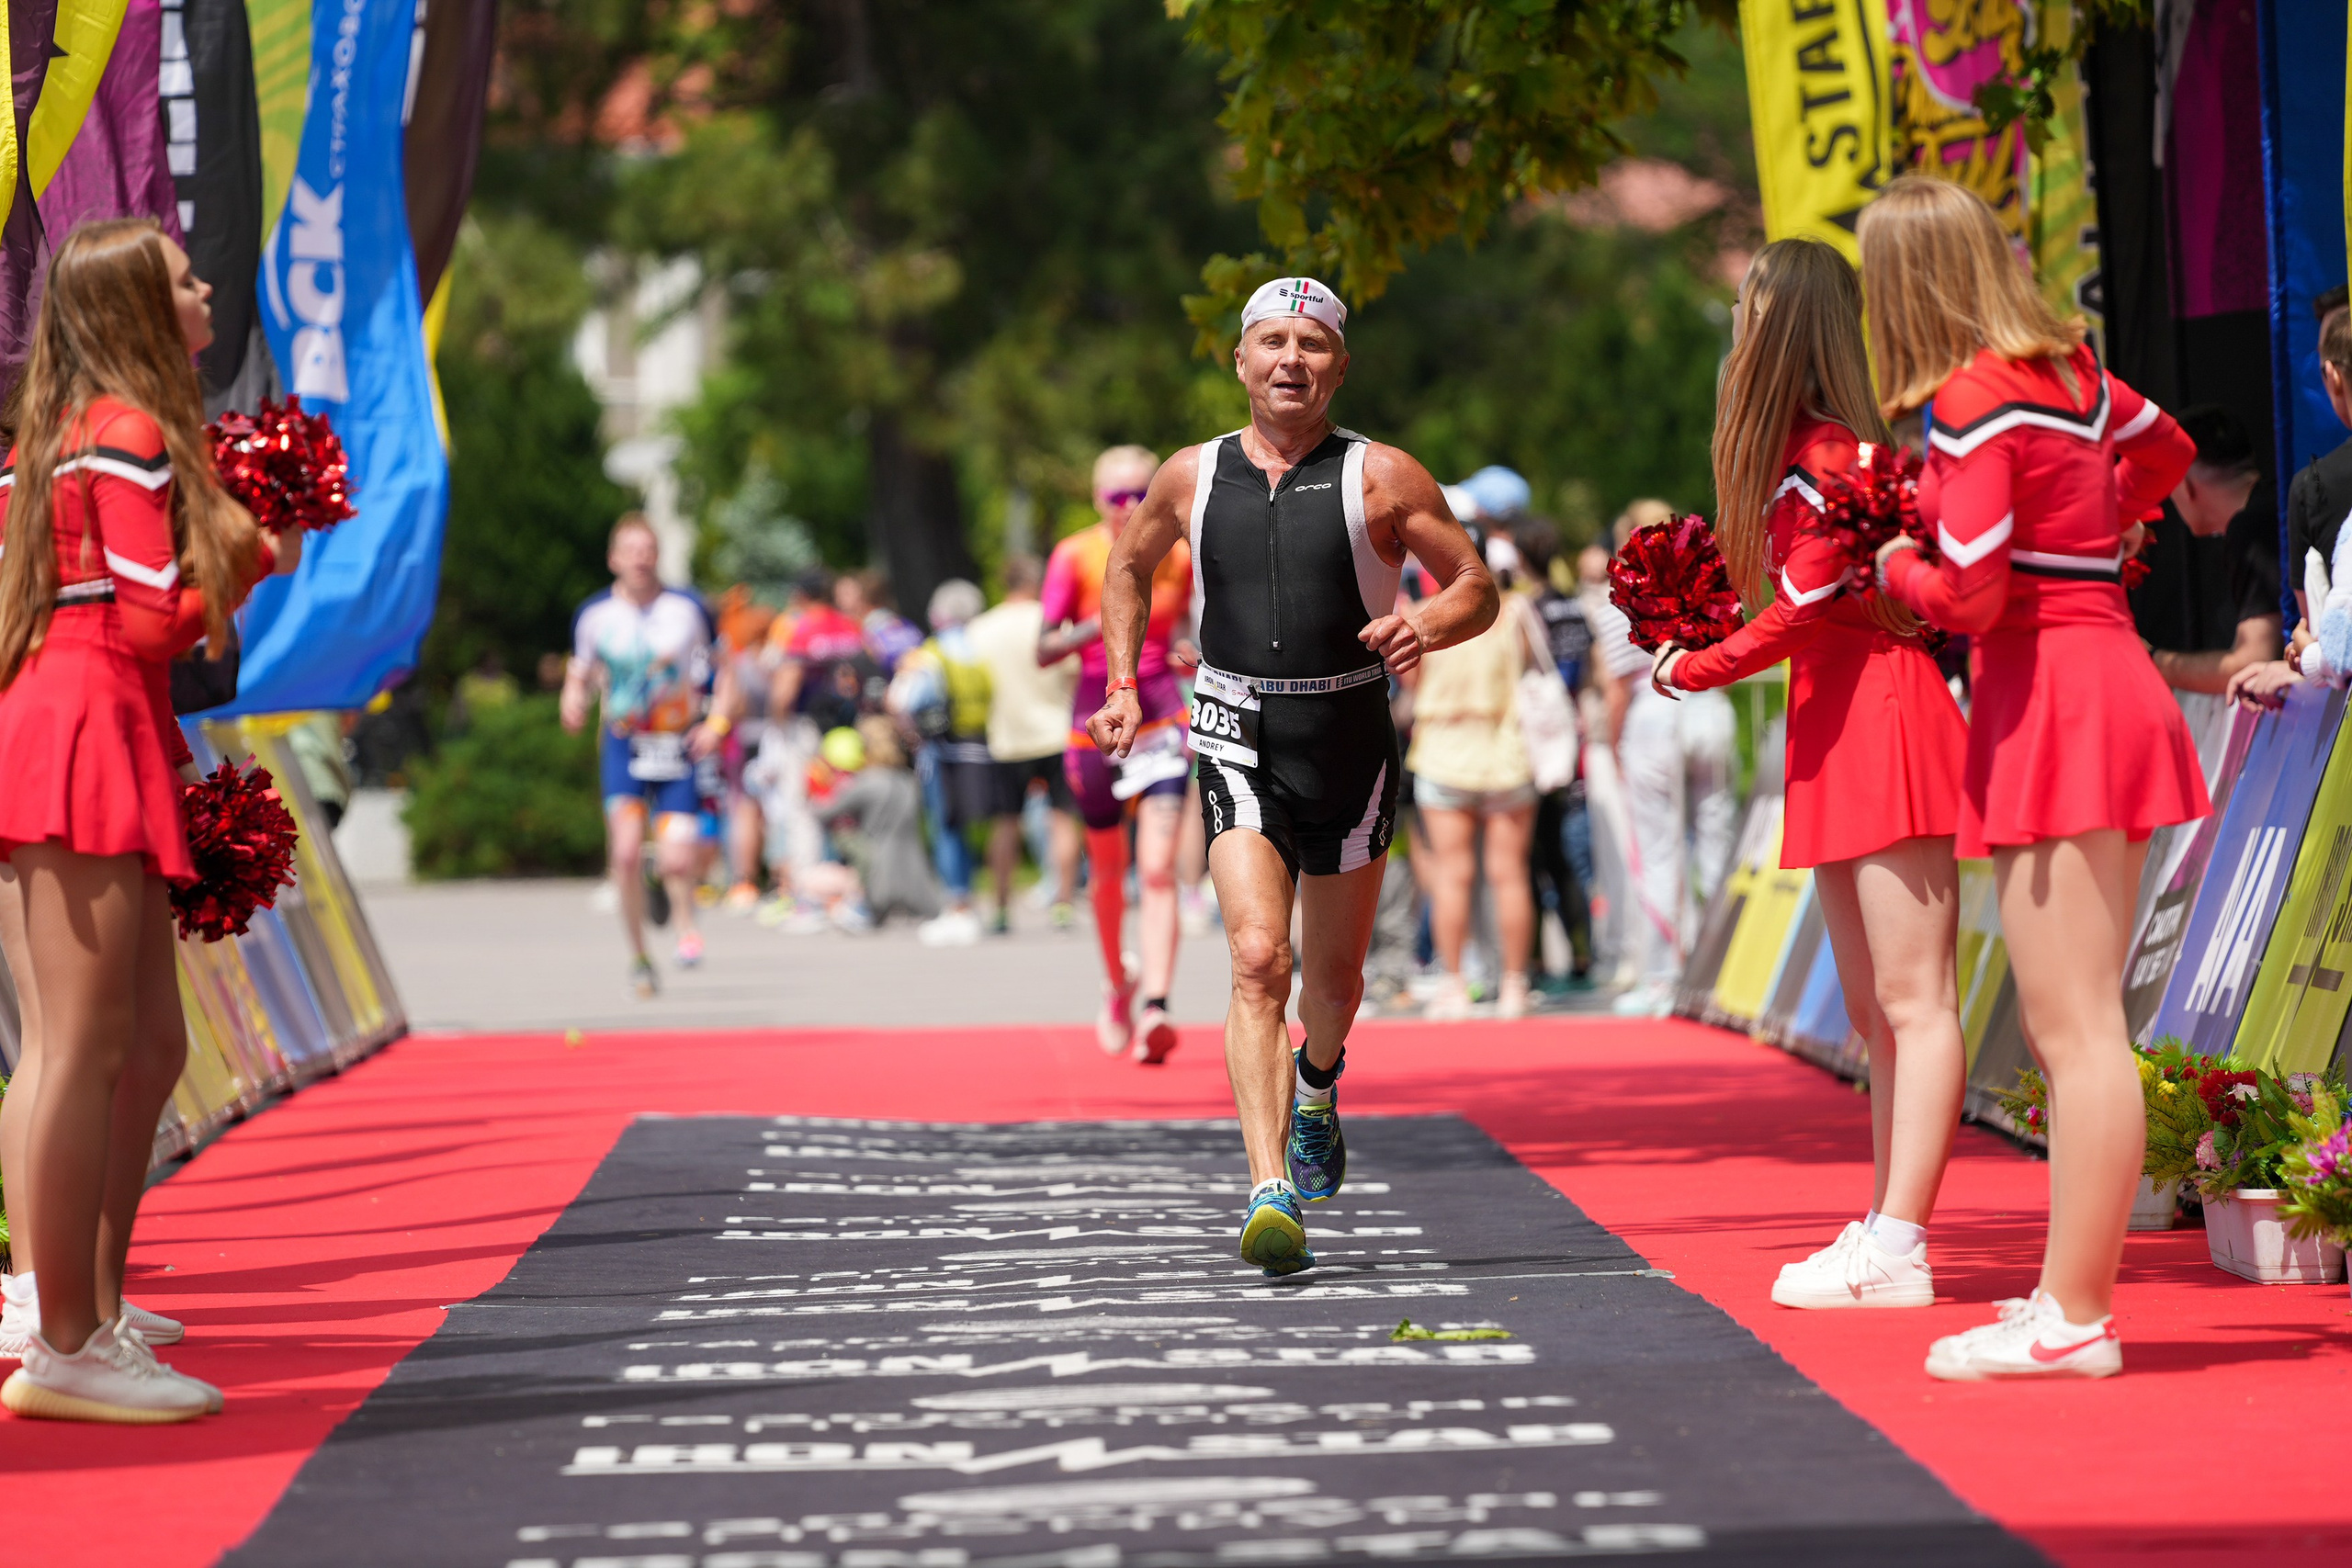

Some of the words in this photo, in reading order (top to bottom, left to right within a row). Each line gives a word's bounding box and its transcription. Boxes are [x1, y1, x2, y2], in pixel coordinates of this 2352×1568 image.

[1290, 292, 1324, 304] sportful
[1295, 482, 1332, 492] orca
[1260, 680, 1284, 693] ABU
[1290, 679, 1331, 693] DHABI
[1190, 698, 1242, 739] 3035
[1199, 739, 1225, 752] ANDREY
